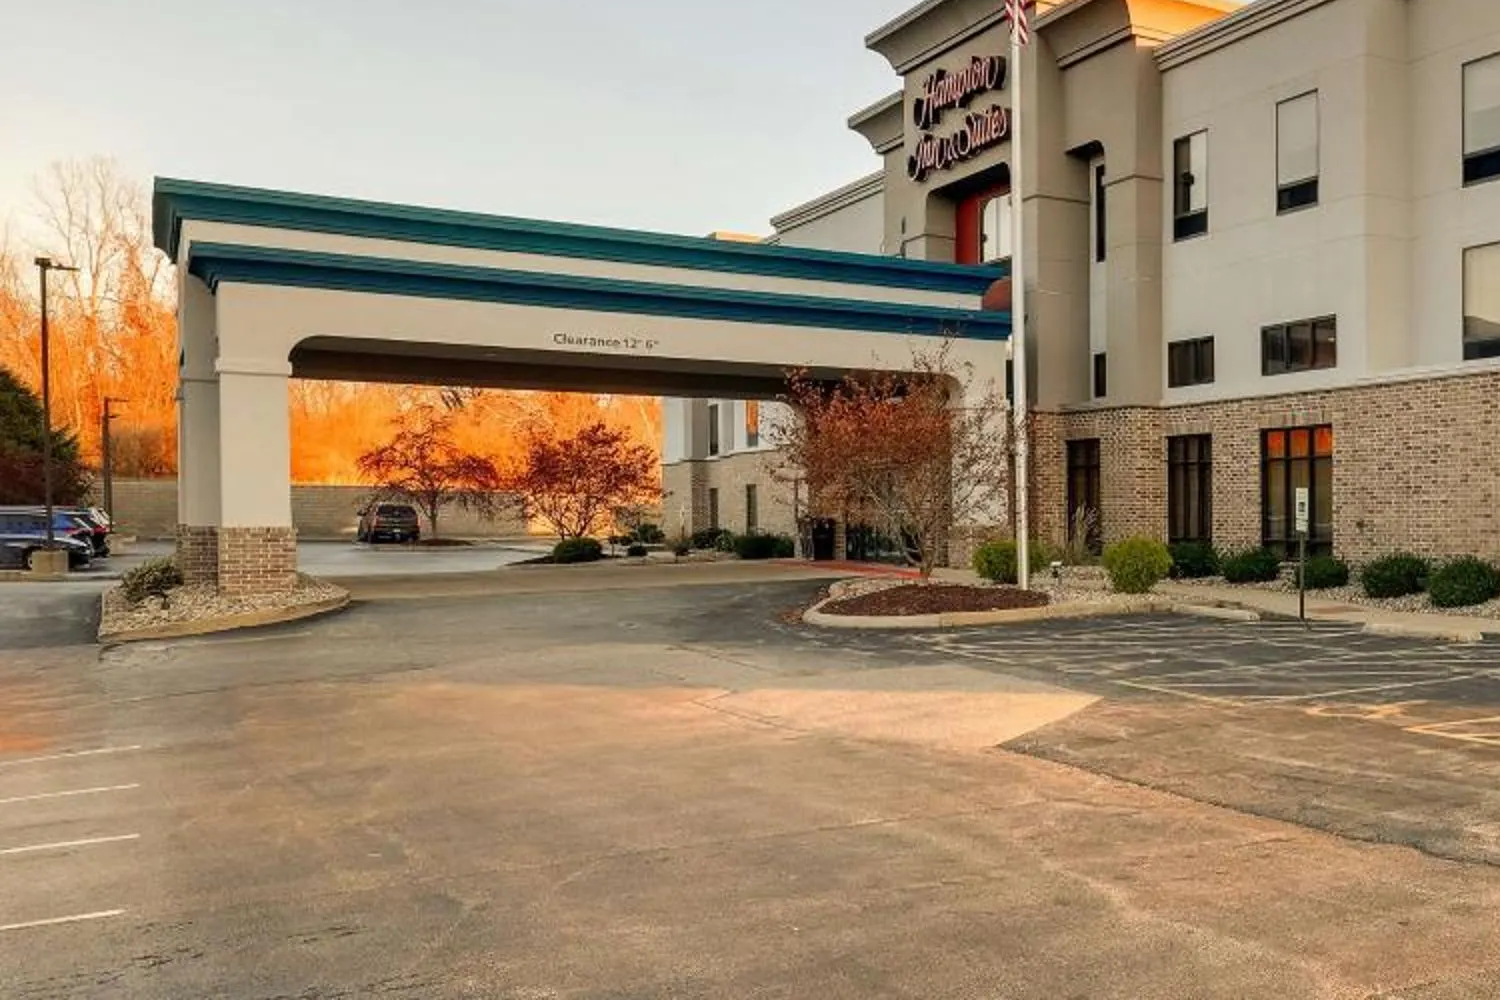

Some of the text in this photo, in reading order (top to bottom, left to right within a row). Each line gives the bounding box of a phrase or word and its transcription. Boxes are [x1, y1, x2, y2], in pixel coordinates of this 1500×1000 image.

[914, 56, 1006, 130] Hampton
[908, 133, 947, 182] Inn
[956, 104, 1012, 157] Suites
[553, 333, 621, 347] Clearance
